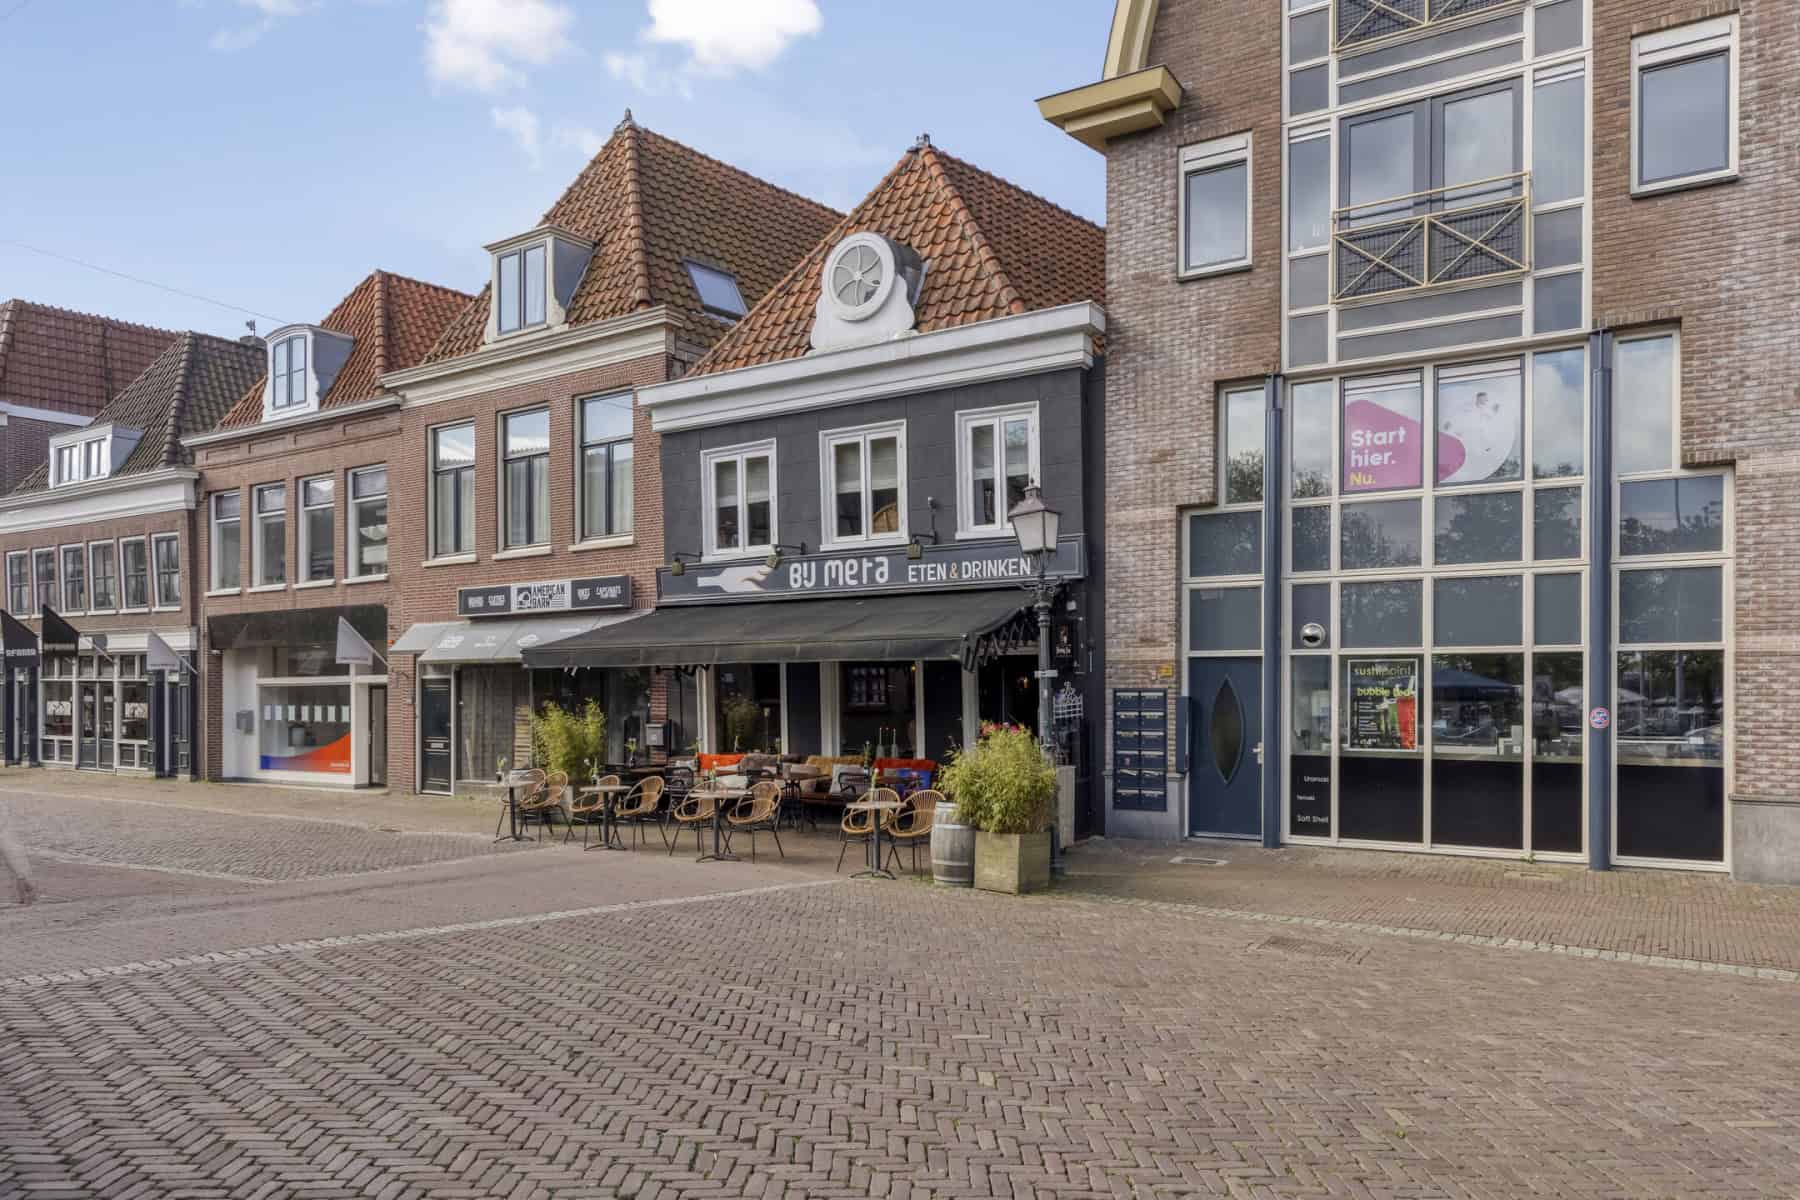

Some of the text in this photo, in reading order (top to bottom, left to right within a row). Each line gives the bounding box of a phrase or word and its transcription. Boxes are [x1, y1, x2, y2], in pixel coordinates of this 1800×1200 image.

[1351, 427, 1406, 447] Start
[1351, 449, 1396, 467] hier.
[1350, 472, 1376, 485] Nu.
[907, 556, 1031, 582] ETEN & DRINKEN
[1357, 686, 1391, 697] bubble
